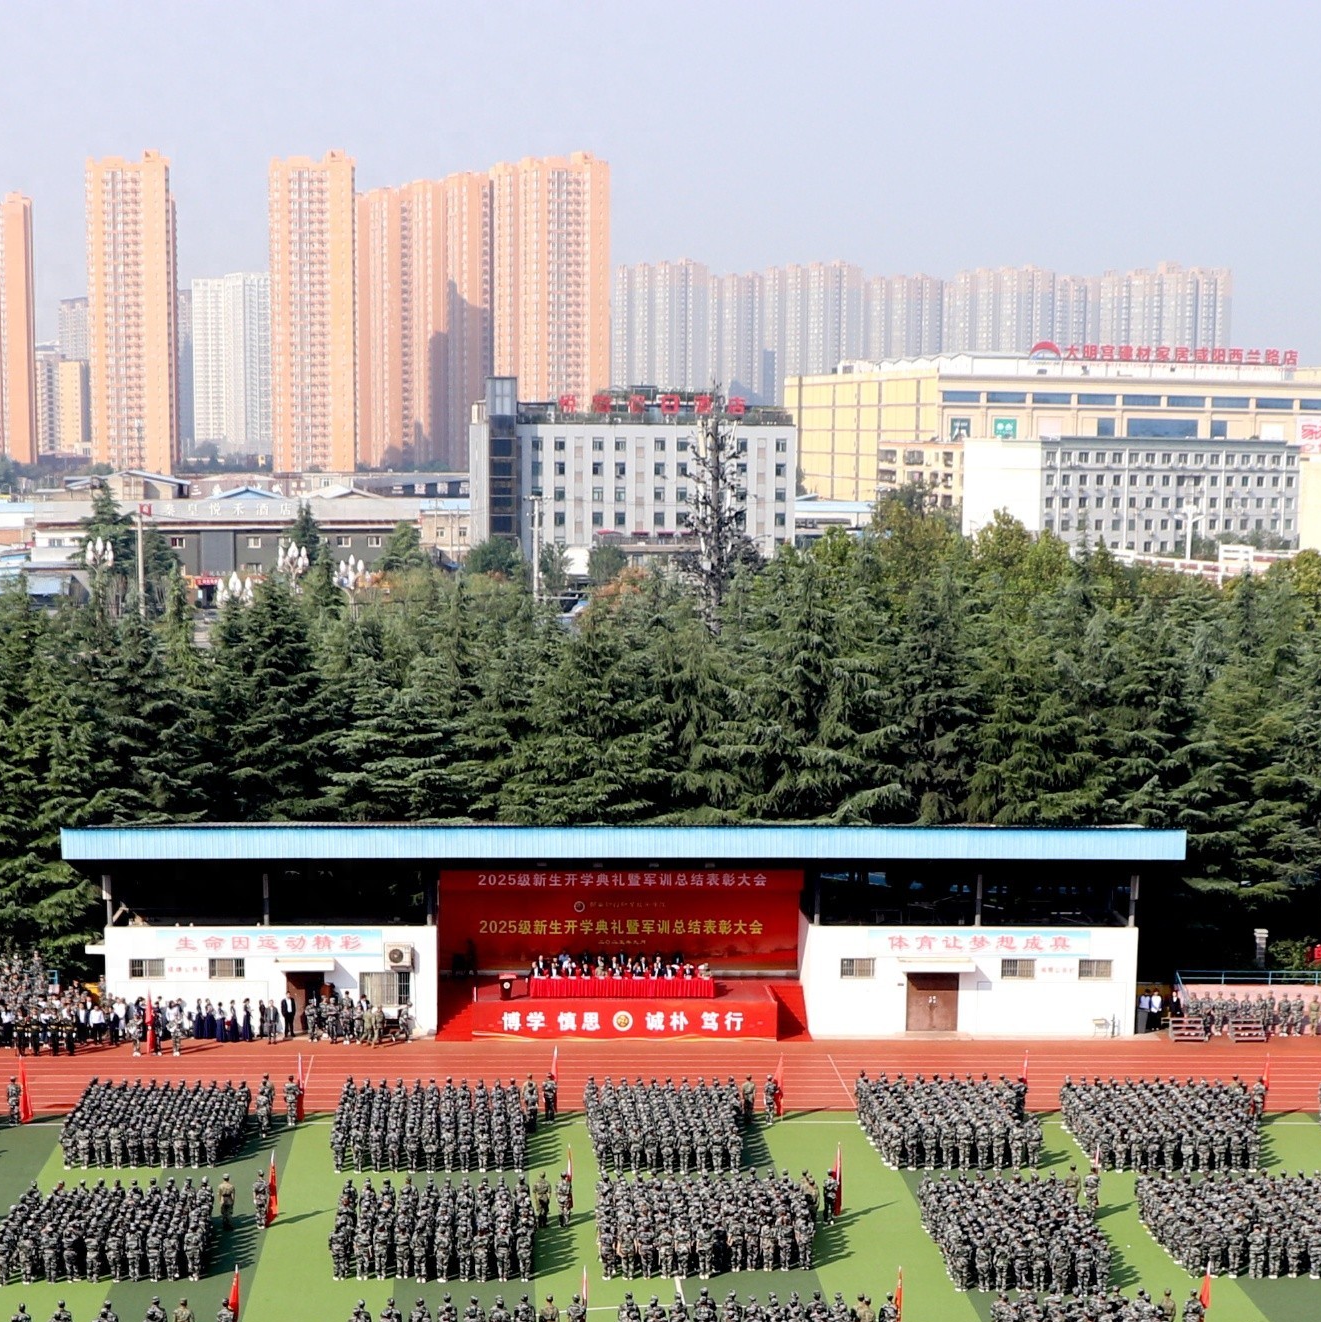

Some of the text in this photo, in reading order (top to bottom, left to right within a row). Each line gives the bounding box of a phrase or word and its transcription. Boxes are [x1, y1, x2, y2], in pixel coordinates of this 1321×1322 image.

[478, 872, 768, 888] 2025级新生开学典礼暨军训总结表彰大会
[479, 919, 764, 936] 2025级新生开学典礼暨军训总结表彰大会
[175, 934, 364, 952] 生命因运动精彩
[887, 935, 1072, 952] 体育让梦想成真
[501, 1011, 744, 1031] 博学 慎思 诚朴 笃行
